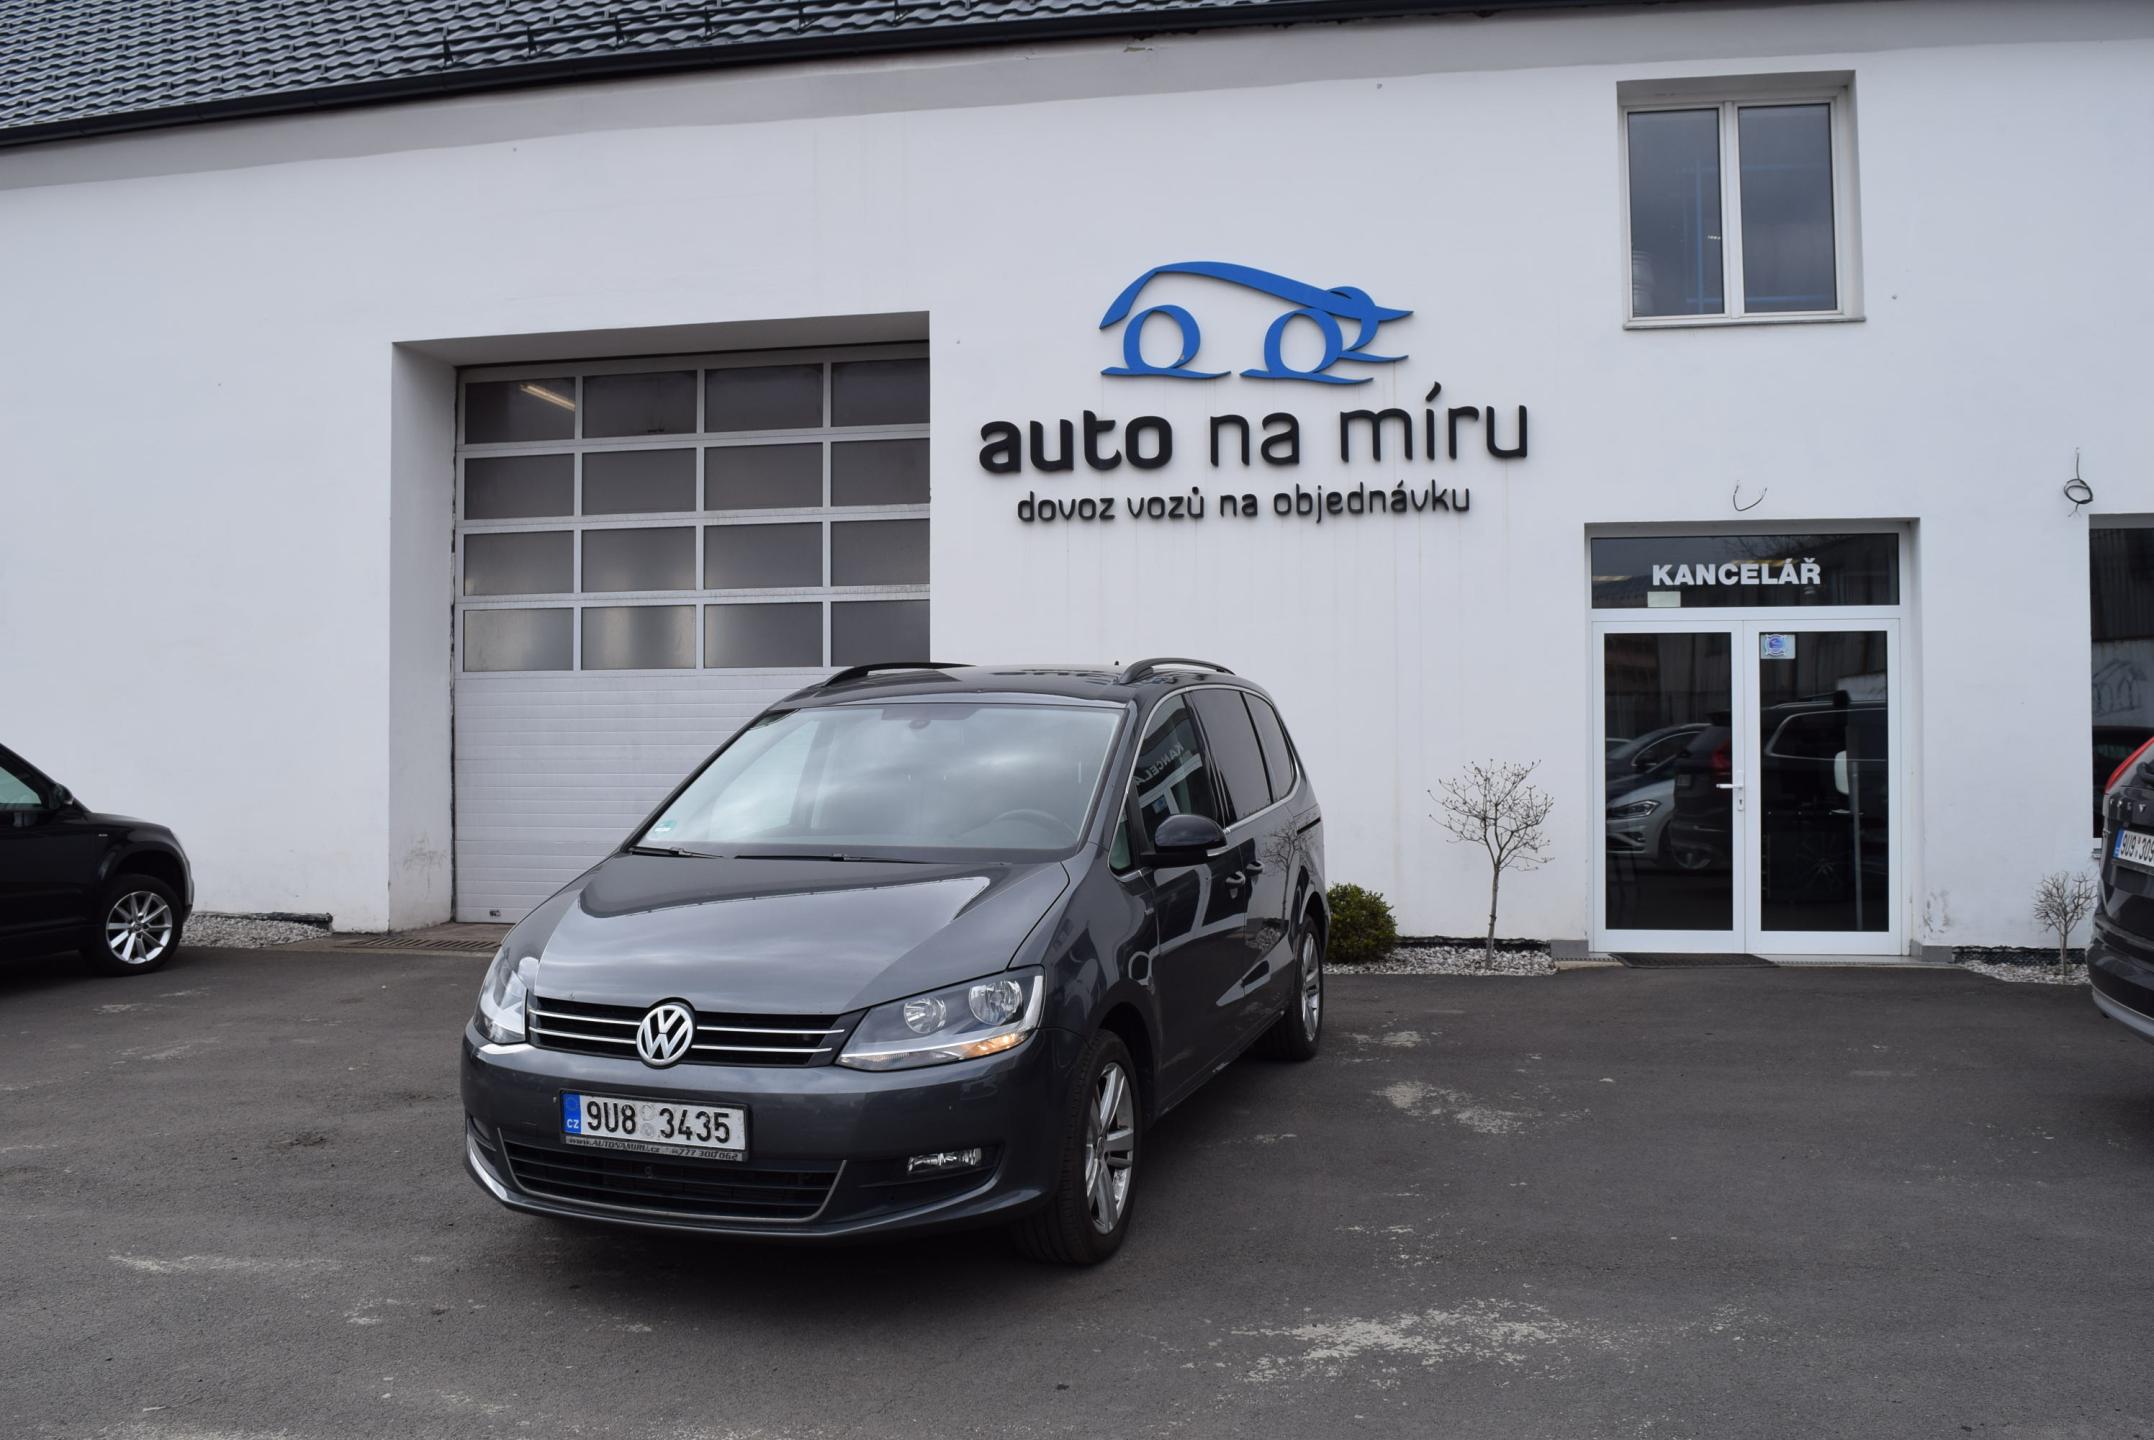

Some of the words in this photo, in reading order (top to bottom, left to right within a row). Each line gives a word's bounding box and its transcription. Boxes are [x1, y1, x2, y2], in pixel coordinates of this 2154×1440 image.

[978, 409, 1173, 475] auto
[1210, 412, 1301, 468] na
[1340, 381, 1528, 464] míru
[1017, 491, 1115, 523] dovoz
[1127, 486, 1204, 521] vozů
[1219, 493, 1259, 518] na
[1273, 479, 1470, 525] objednávku
[1652, 557, 1821, 586] KANCELÁŘ
[566, 1119, 579, 1129] CZ
[586, 1100, 637, 1135] 9U8
[659, 1107, 730, 1144] 3435
